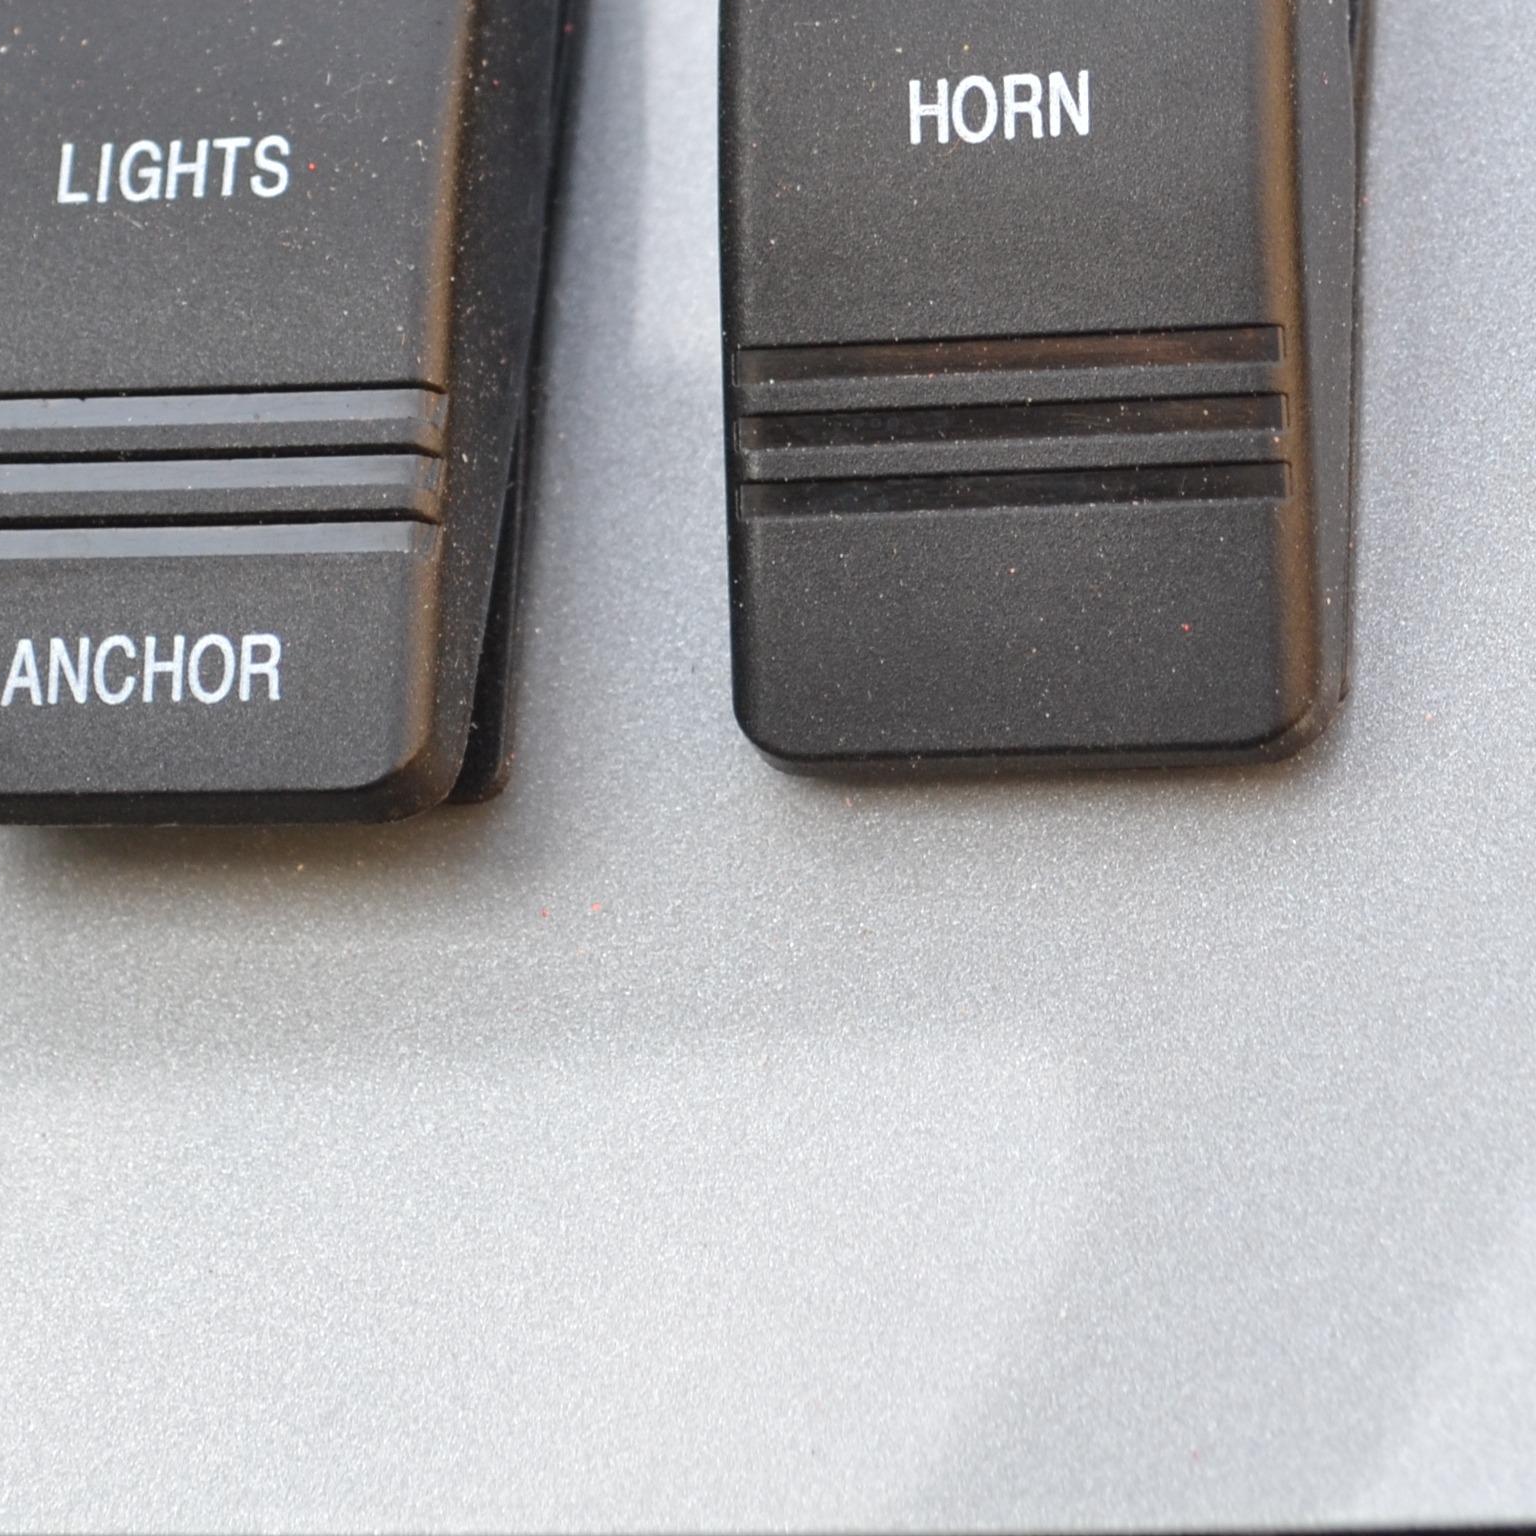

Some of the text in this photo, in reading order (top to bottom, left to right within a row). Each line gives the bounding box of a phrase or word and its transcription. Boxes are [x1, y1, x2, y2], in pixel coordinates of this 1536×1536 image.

[907, 69, 1092, 146] HORN
[57, 135, 292, 206] LIGHTS
[0, 631, 283, 707] ANCHOR
